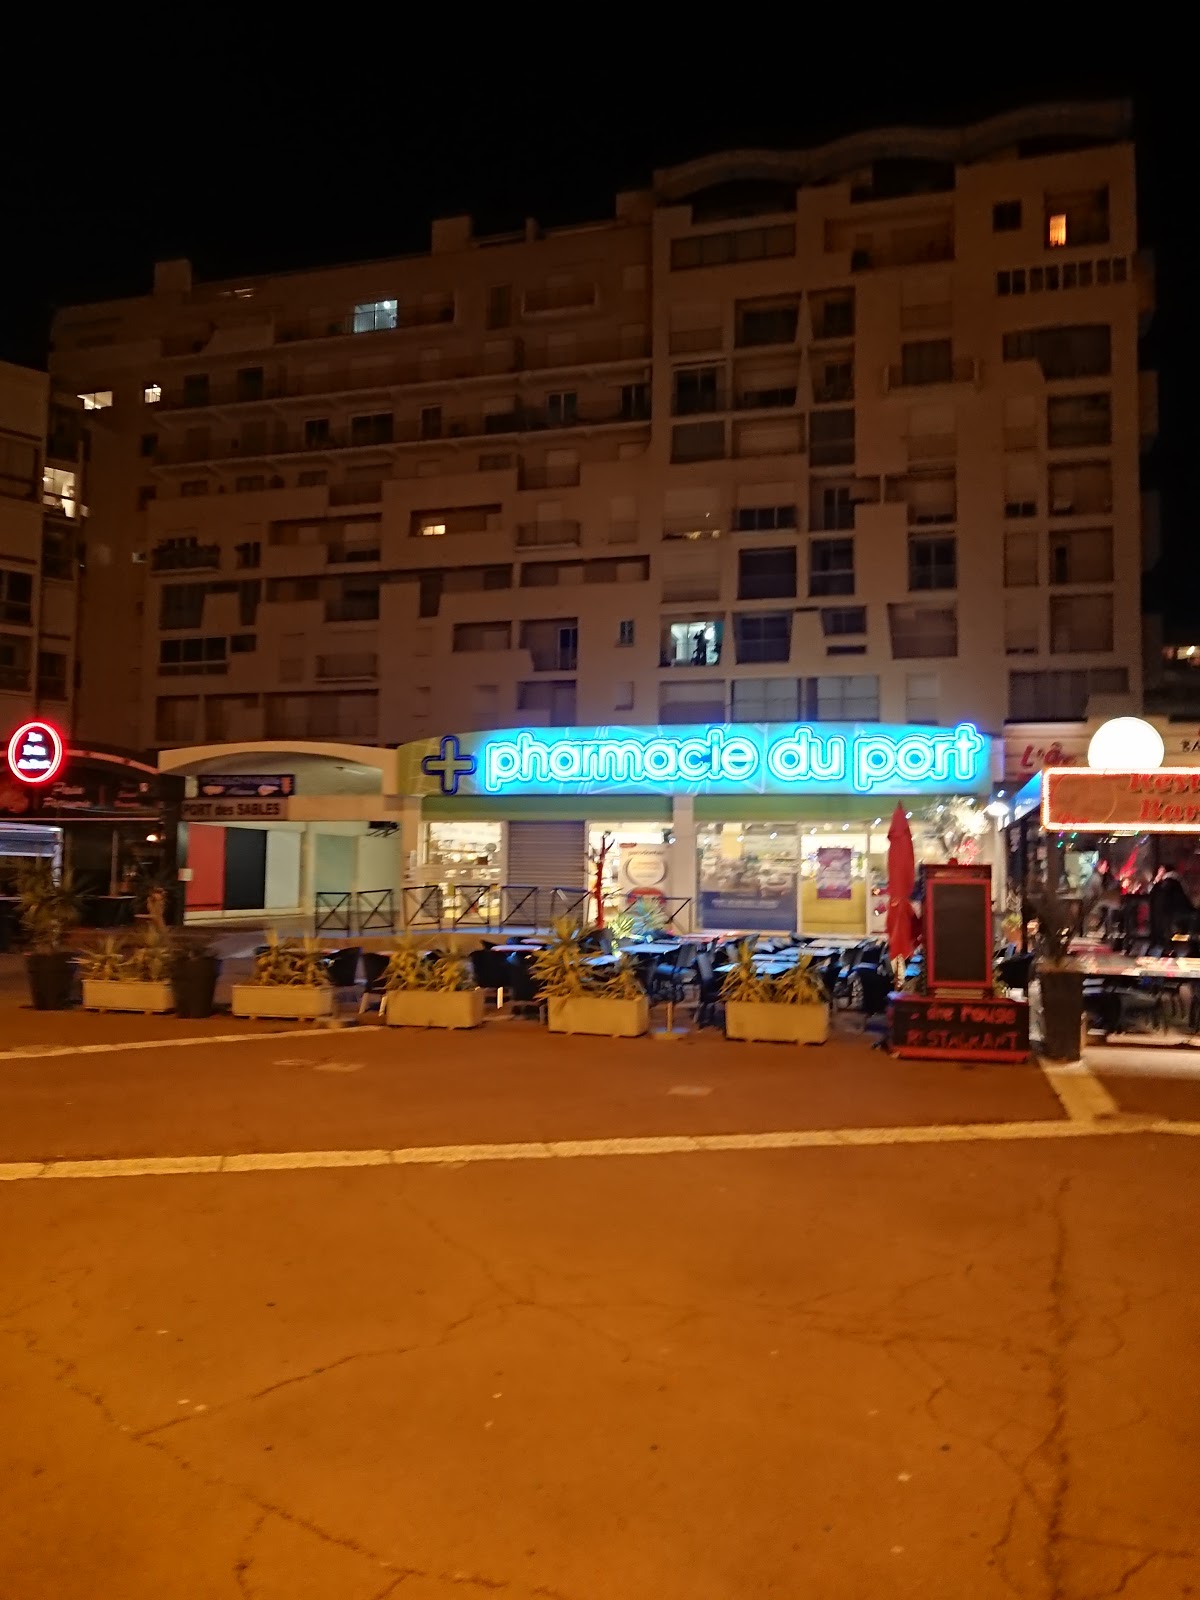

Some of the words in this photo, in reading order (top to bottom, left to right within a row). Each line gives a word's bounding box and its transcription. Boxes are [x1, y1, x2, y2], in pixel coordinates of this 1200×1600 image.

[486, 728, 759, 792] pharmacie
[768, 727, 846, 781] du
[854, 723, 983, 791] port
[183, 803, 212, 816] PORT
[215, 806, 234, 816] des
[236, 802, 280, 816] SABLES
